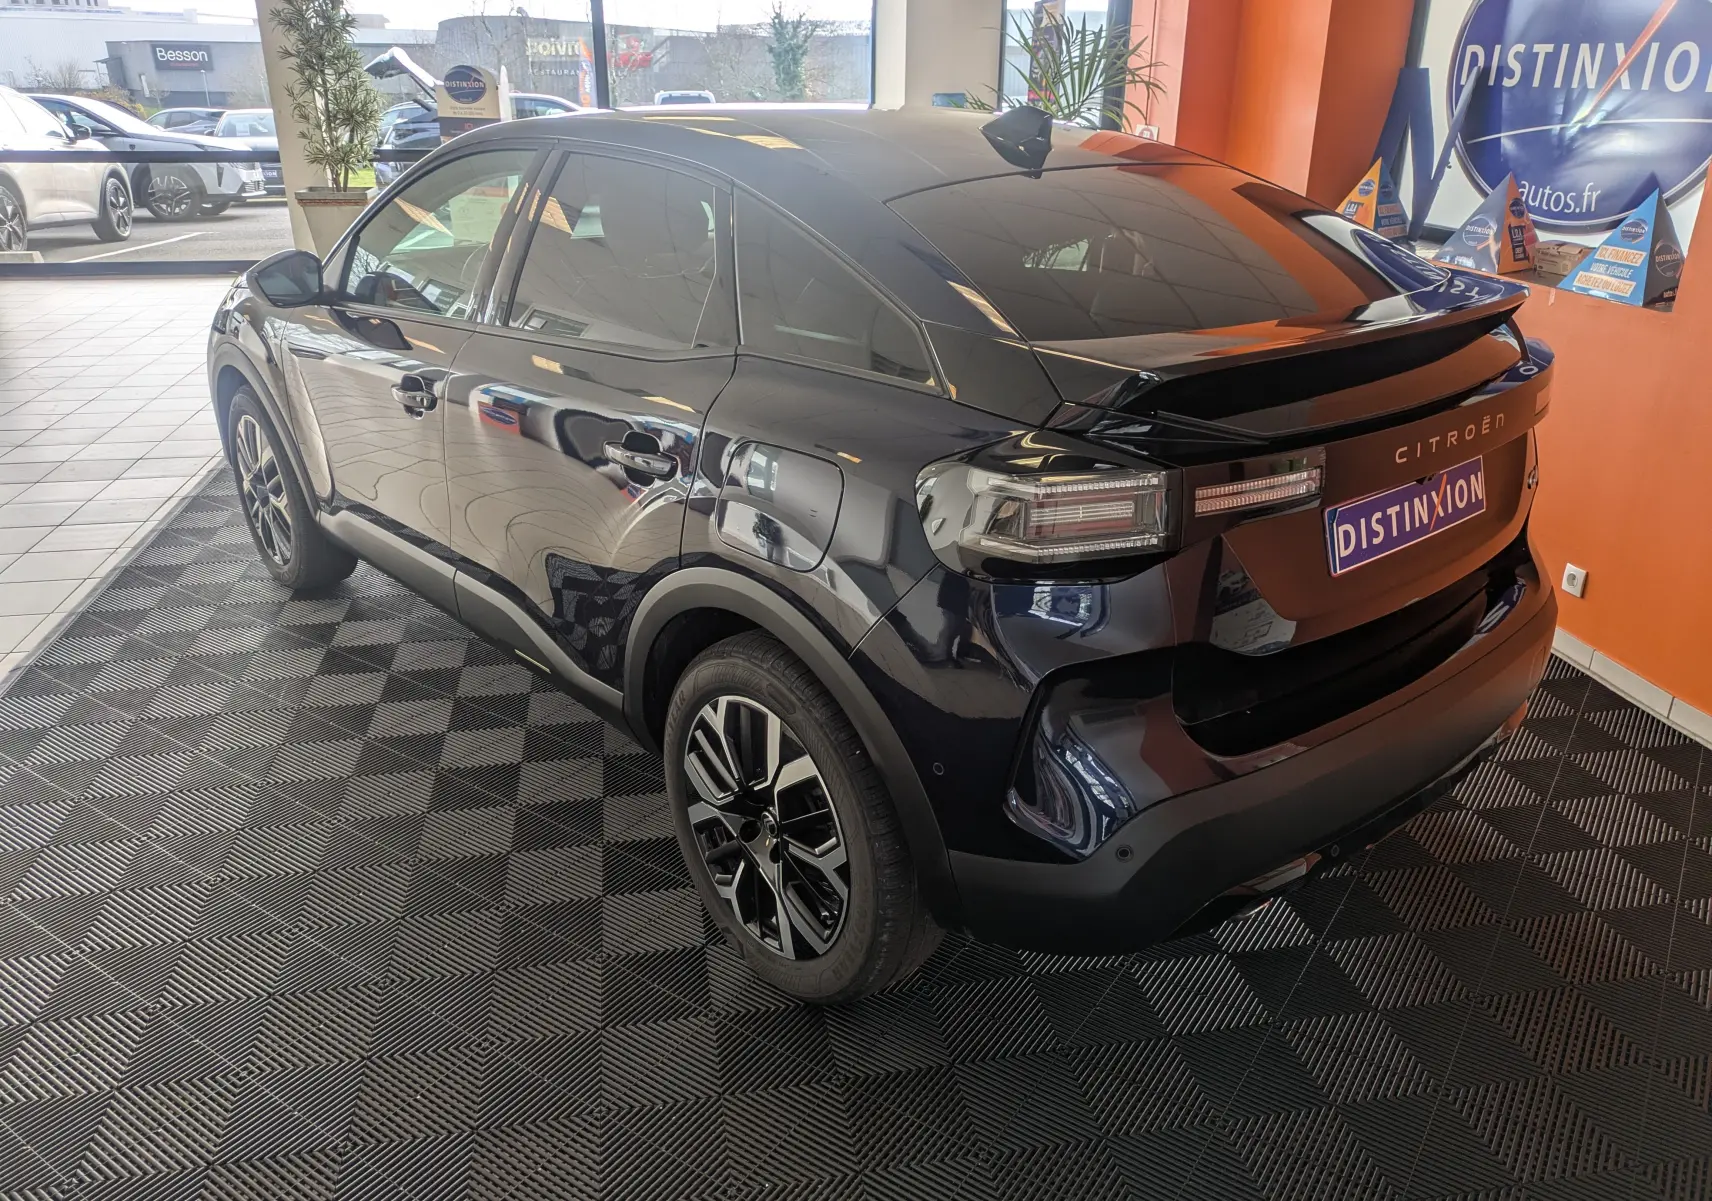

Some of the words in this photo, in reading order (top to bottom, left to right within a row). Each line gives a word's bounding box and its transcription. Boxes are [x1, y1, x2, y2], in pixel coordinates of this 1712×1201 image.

[156, 47, 208, 61] Besson
[1518, 180, 1601, 214] autos.fr
[1338, 471, 1483, 558] DISTINXION
